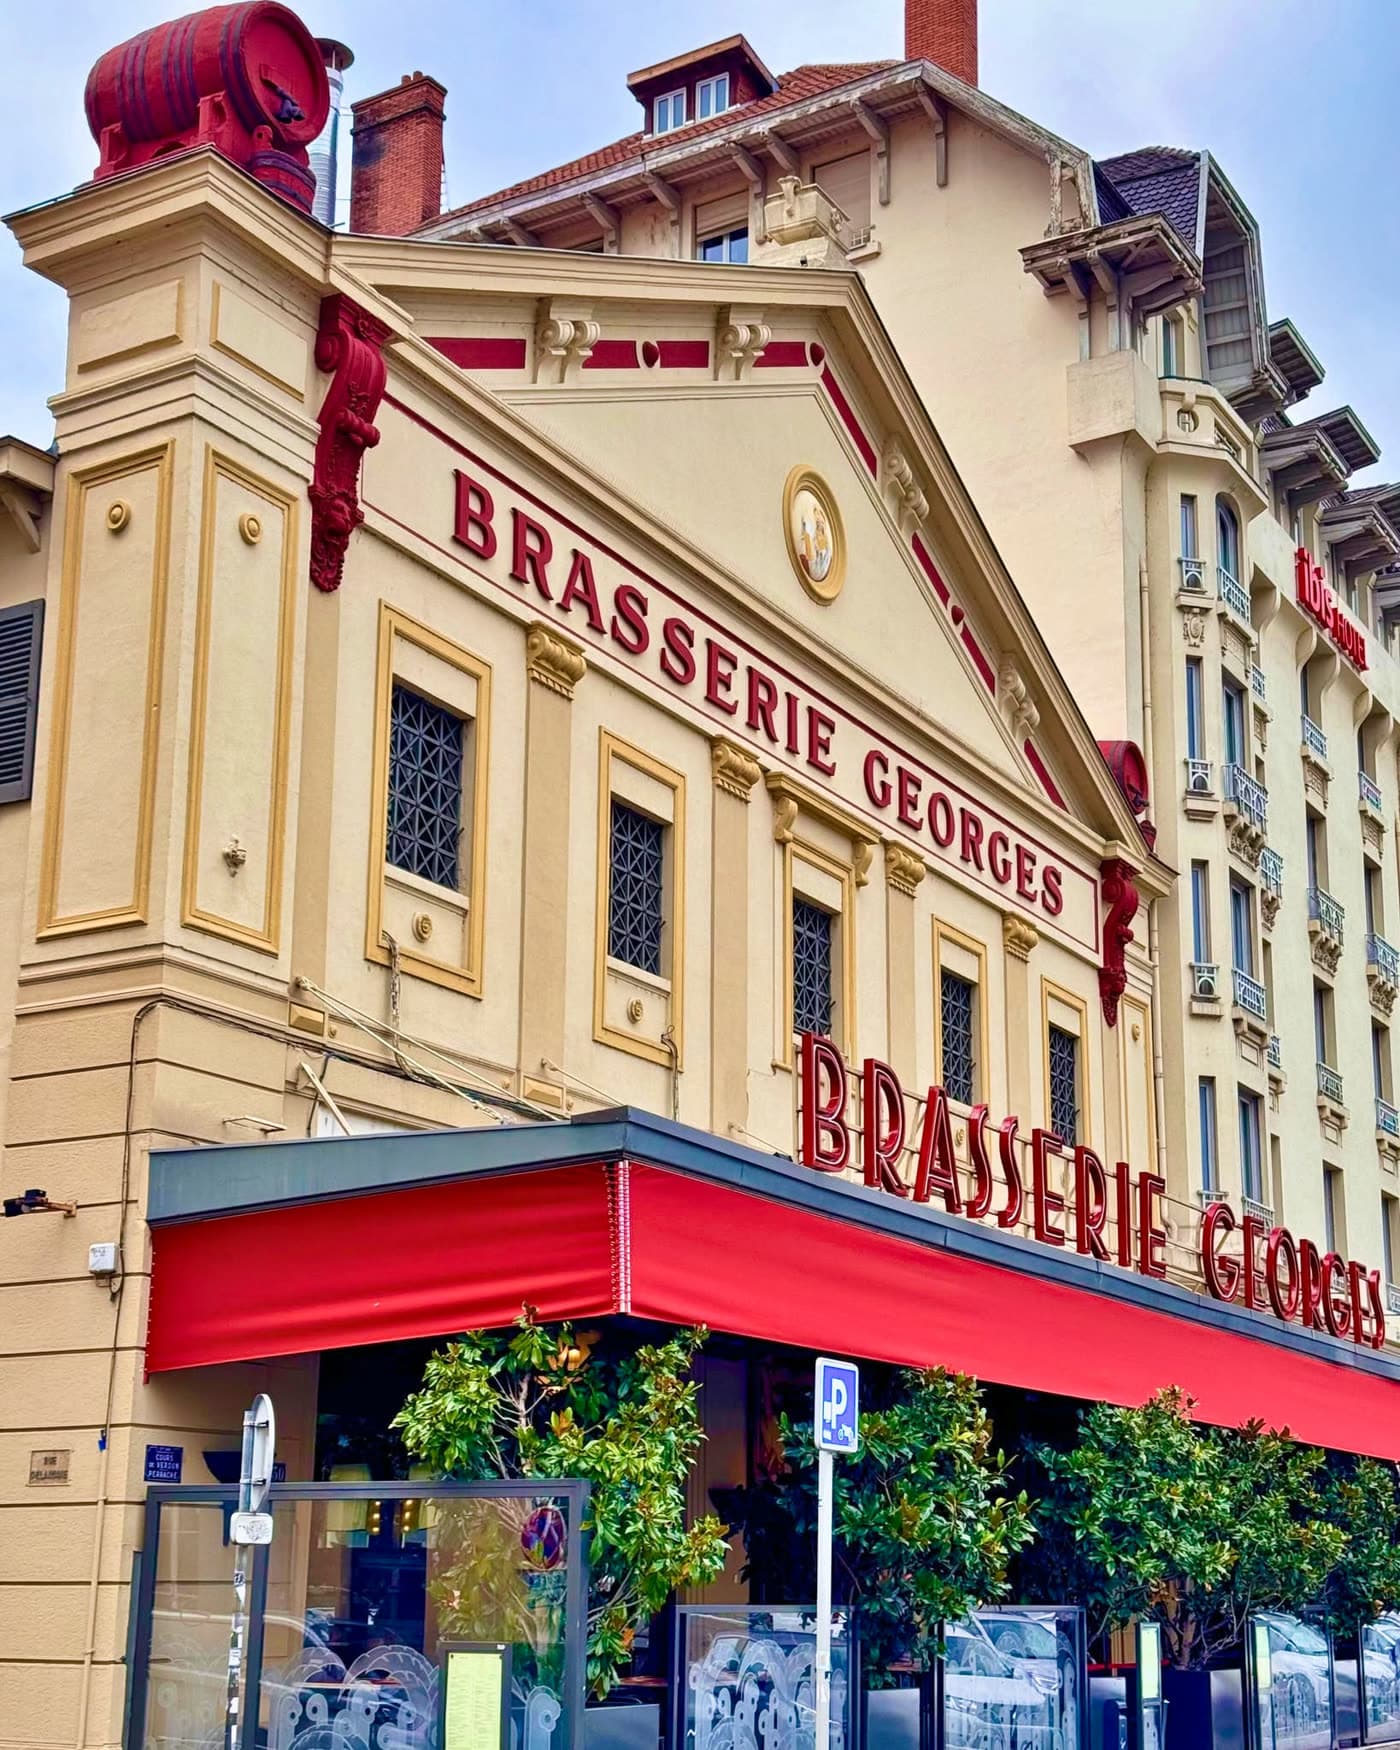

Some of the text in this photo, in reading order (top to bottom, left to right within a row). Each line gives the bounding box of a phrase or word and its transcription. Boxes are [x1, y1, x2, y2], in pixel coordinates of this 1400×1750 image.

[453, 468, 1064, 916] BRASSERIE GEORGES
[1294, 547, 1335, 631] ibis
[801, 1032, 1386, 1350] BRASSERIE GEORGES
